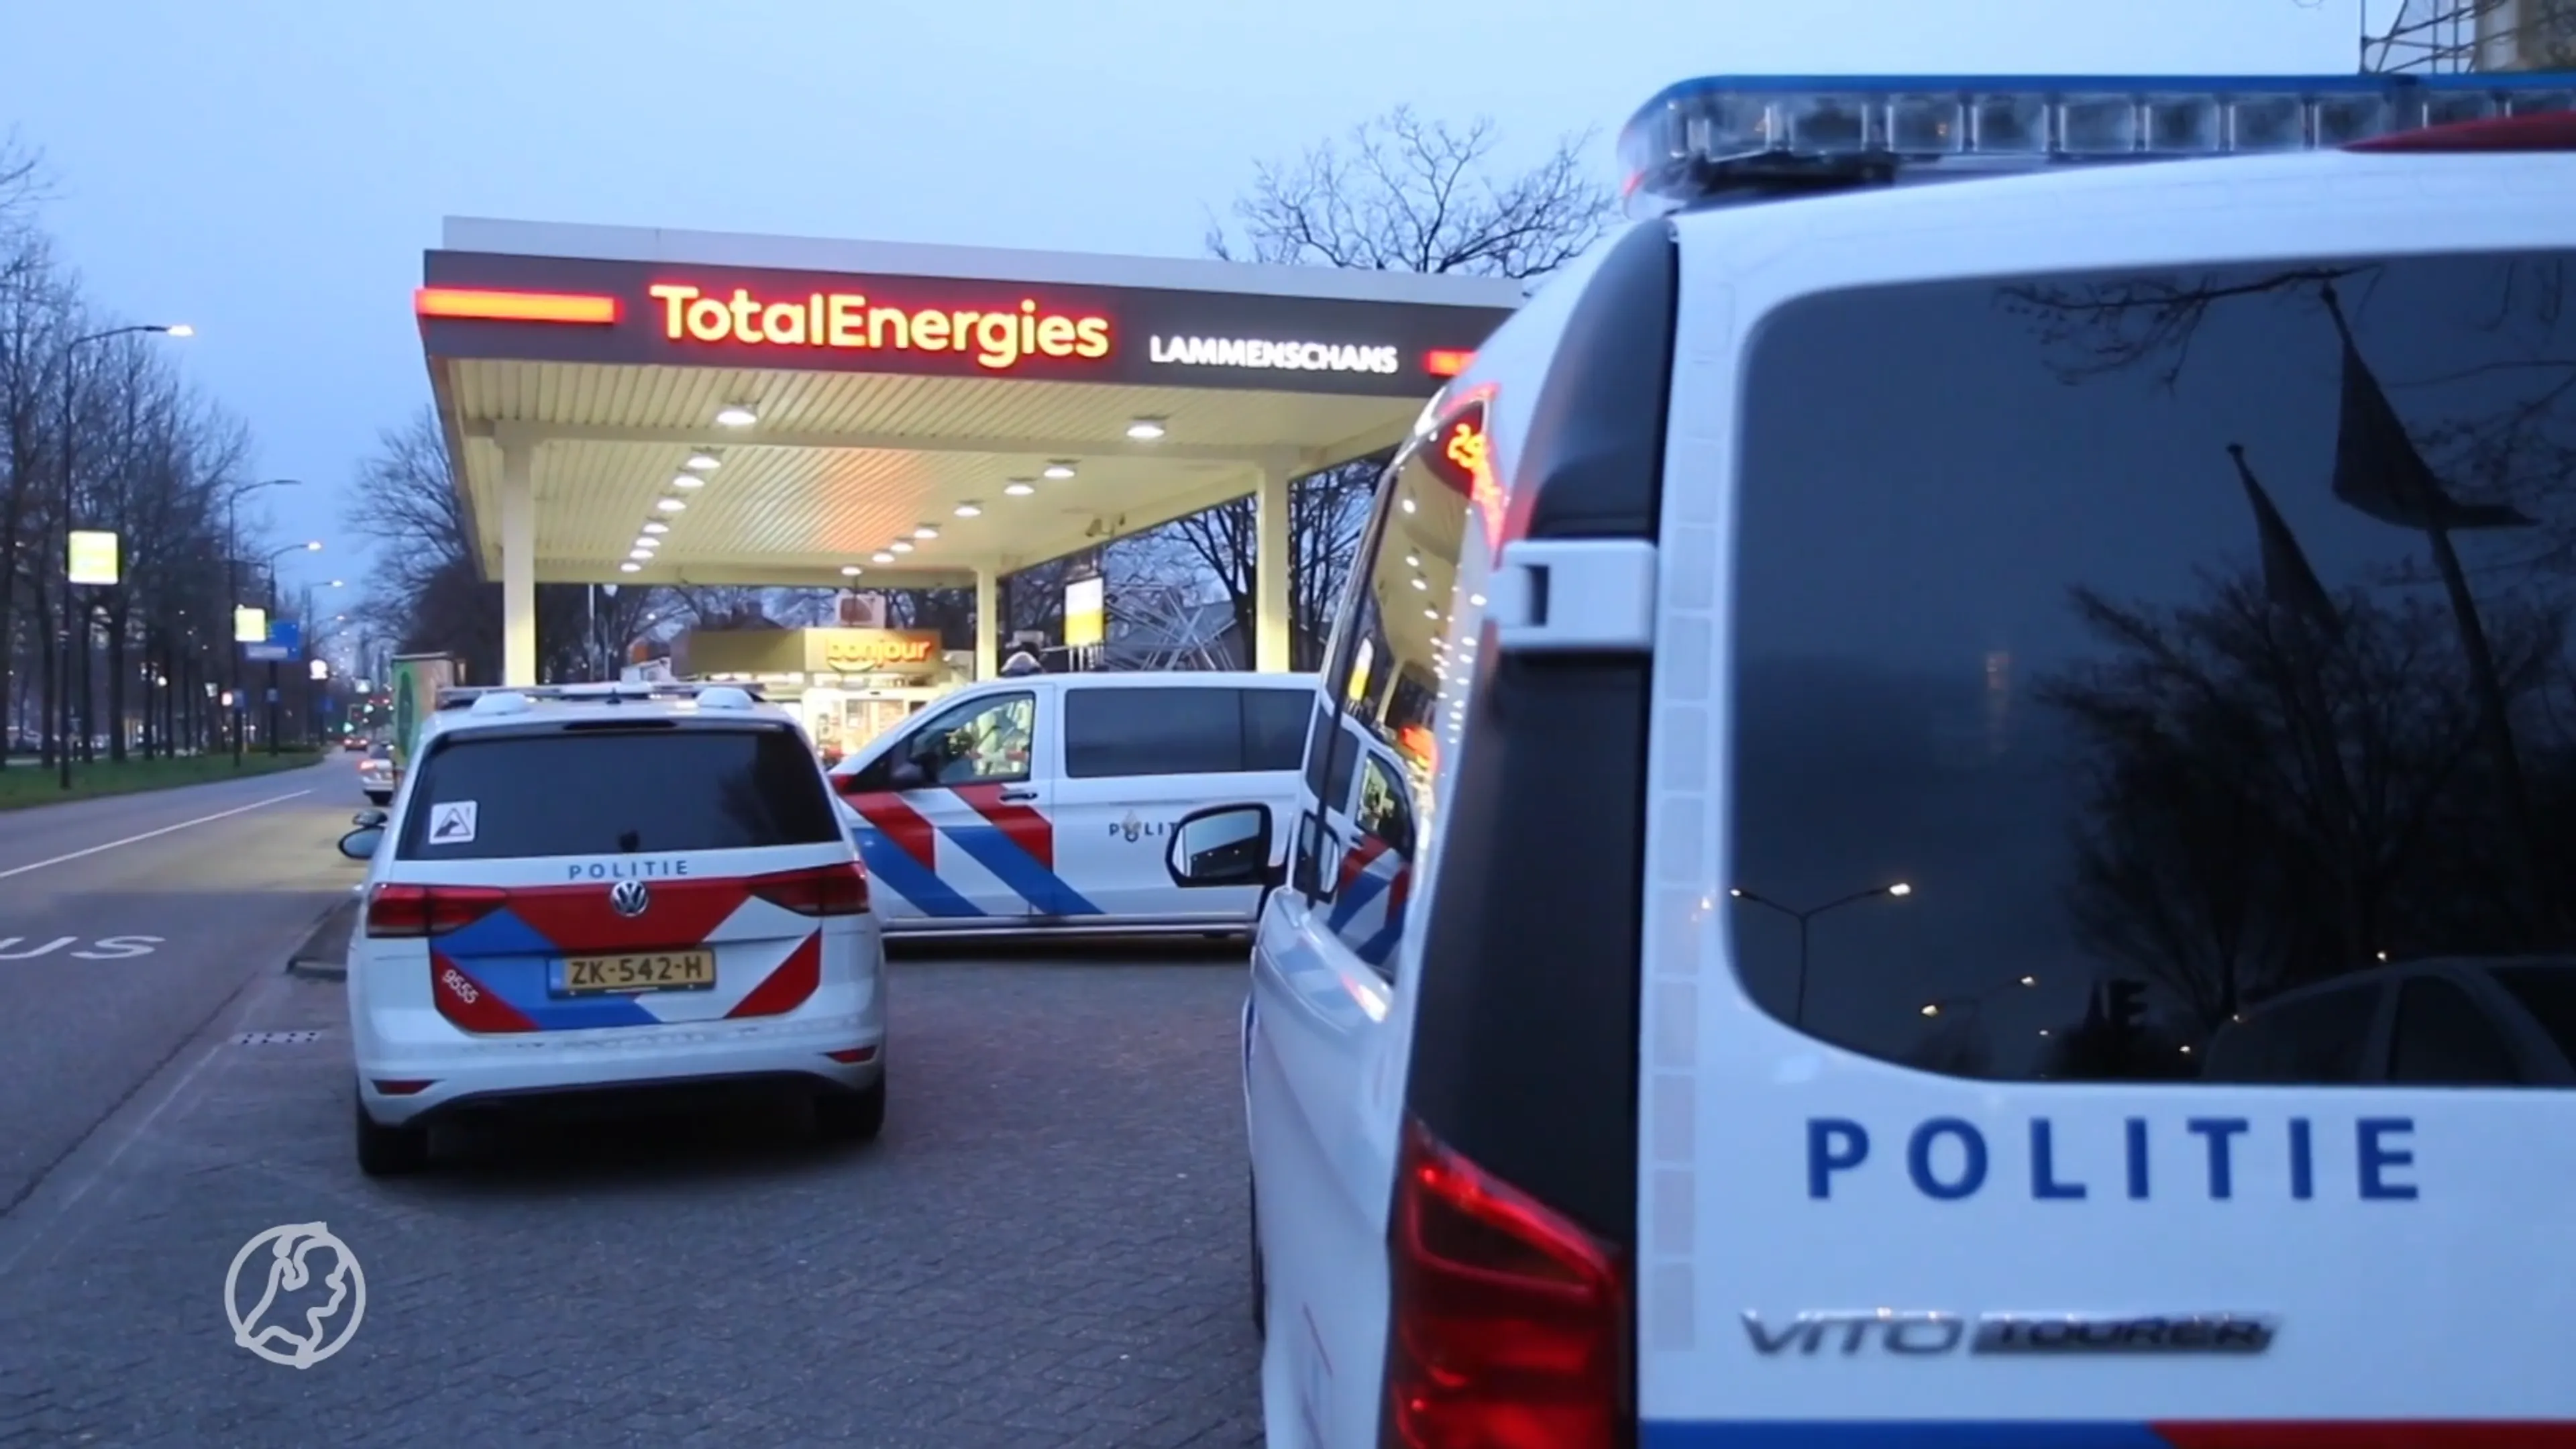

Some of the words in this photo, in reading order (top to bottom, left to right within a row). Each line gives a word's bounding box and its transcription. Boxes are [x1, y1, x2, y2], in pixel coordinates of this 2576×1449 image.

[649, 284, 1110, 369] TotalEnergies
[1150, 335, 1399, 374] LAMMENSCHANS
[826, 637, 930, 668] bonjour
[568, 859, 690, 880] POLITIE
[442, 969, 480, 1004] 9555
[571, 955, 703, 985] ZK-542-H
[1805, 1116, 2420, 1201] POLITIE
[1741, 1311, 1966, 1356] VITO
[1976, 1313, 2277, 1355] TOURER
